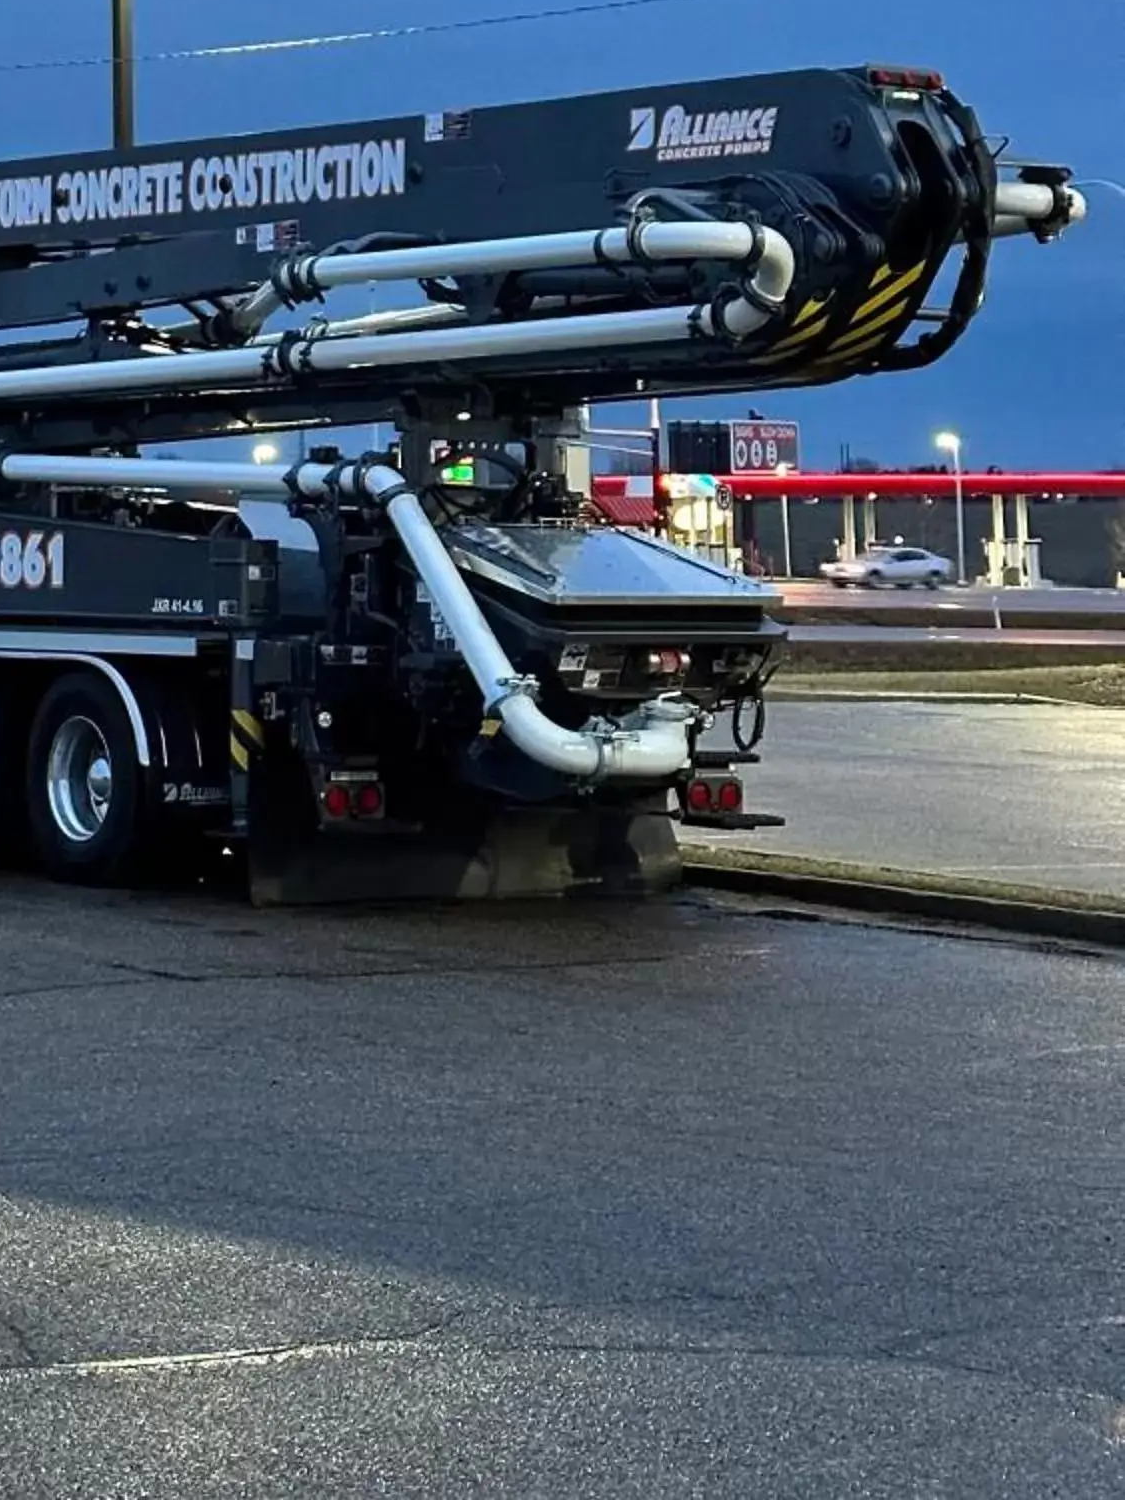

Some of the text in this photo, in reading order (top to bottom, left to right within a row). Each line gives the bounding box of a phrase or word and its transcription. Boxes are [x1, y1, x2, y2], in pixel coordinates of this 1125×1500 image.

[657, 104, 779, 148] ALLIANCE
[657, 140, 772, 162] CONCRETE PUMPS
[56, 161, 183, 224] CONCRETE
[189, 138, 407, 211] CONSTRUCTION
